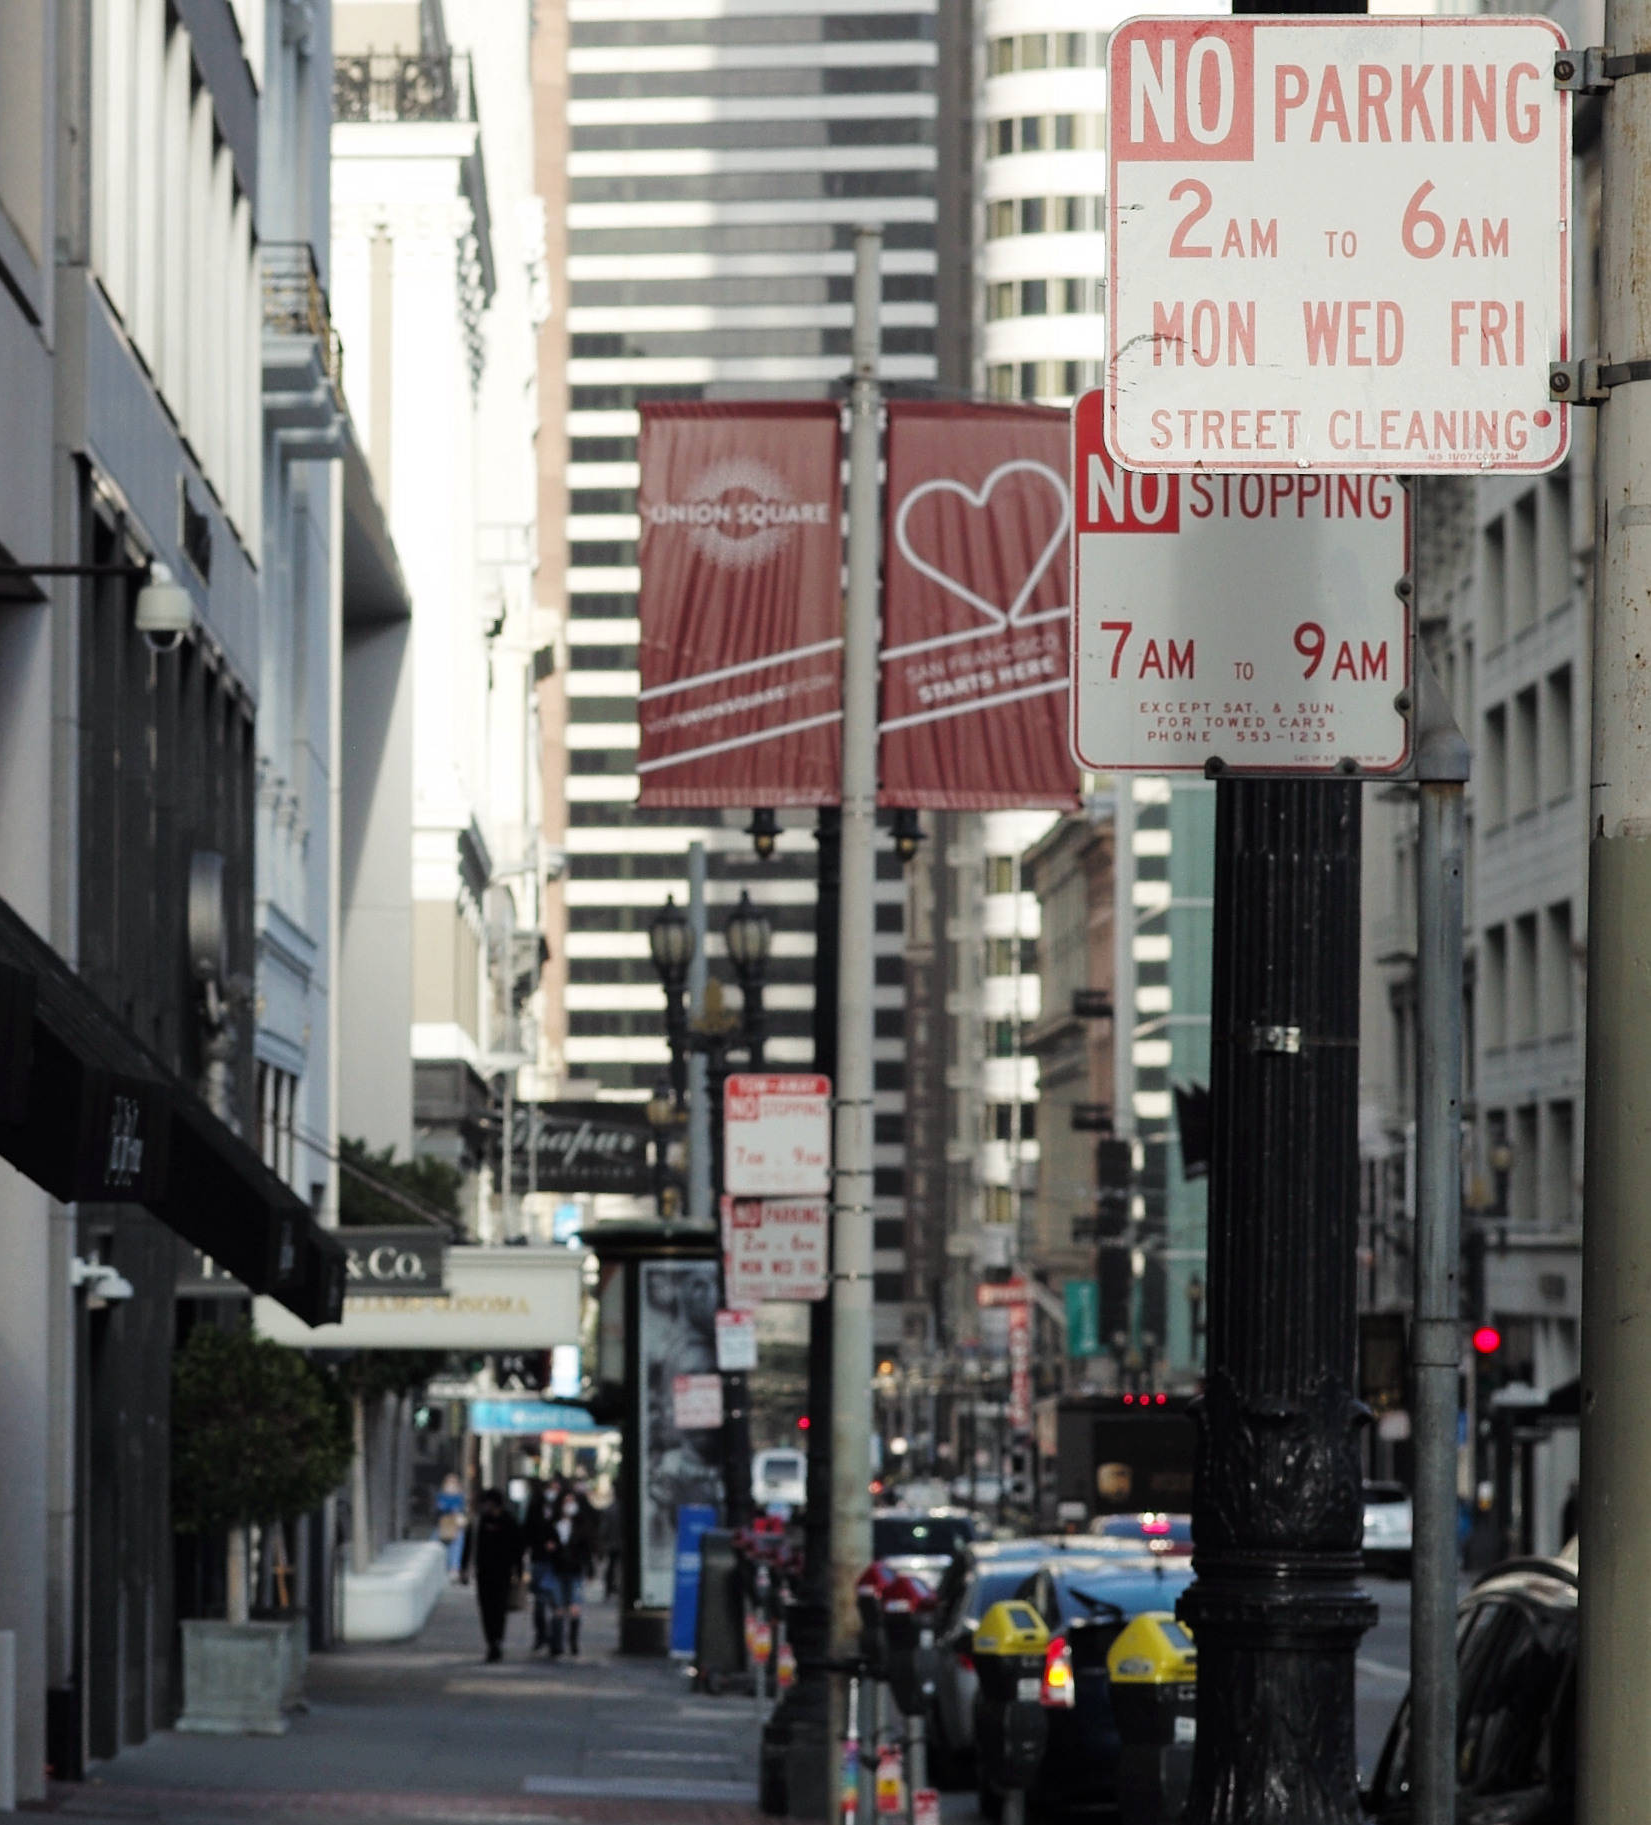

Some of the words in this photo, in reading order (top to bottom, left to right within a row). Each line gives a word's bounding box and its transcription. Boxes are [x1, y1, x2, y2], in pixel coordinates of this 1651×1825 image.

[1129, 37, 1236, 145] NO
[1273, 61, 1541, 145] PARKING
[1168, 178, 1279, 259] 2AM
[1324, 230, 1358, 259] TO
[1400, 179, 1511, 260] 6AM
[1152, 299, 1257, 368] MON
[1302, 299, 1405, 367] WED
[1450, 299, 1526, 367] FRI
[1150, 408, 1301, 451] STREET
[1328, 408, 1529, 451] CLEANING
[650, 503, 731, 526] UNION
[736, 503, 831, 526] SQUARE
[1087, 454, 1169, 524] NO
[1190, 475, 1392, 519] STOPPING
[1099, 620, 1195, 681] 7AM
[1233, 662, 1256, 682] TO
[1292, 620, 1389, 681] 9AM
[917, 670, 995, 705] STARTS
[997, 654, 1056, 684] HERE
[1139, 701, 1212, 714] EXCEPT
[1223, 701, 1259, 714] SAT.
[1272, 701, 1282, 714] &
[1157, 716, 1192, 728] FOR
[1205, 716, 1267, 728] TOWED
[1278, 716, 1327, 729] CARS
[1147, 731, 1211, 743] PHONE
[1236, 731, 1336, 743] 553-1235
